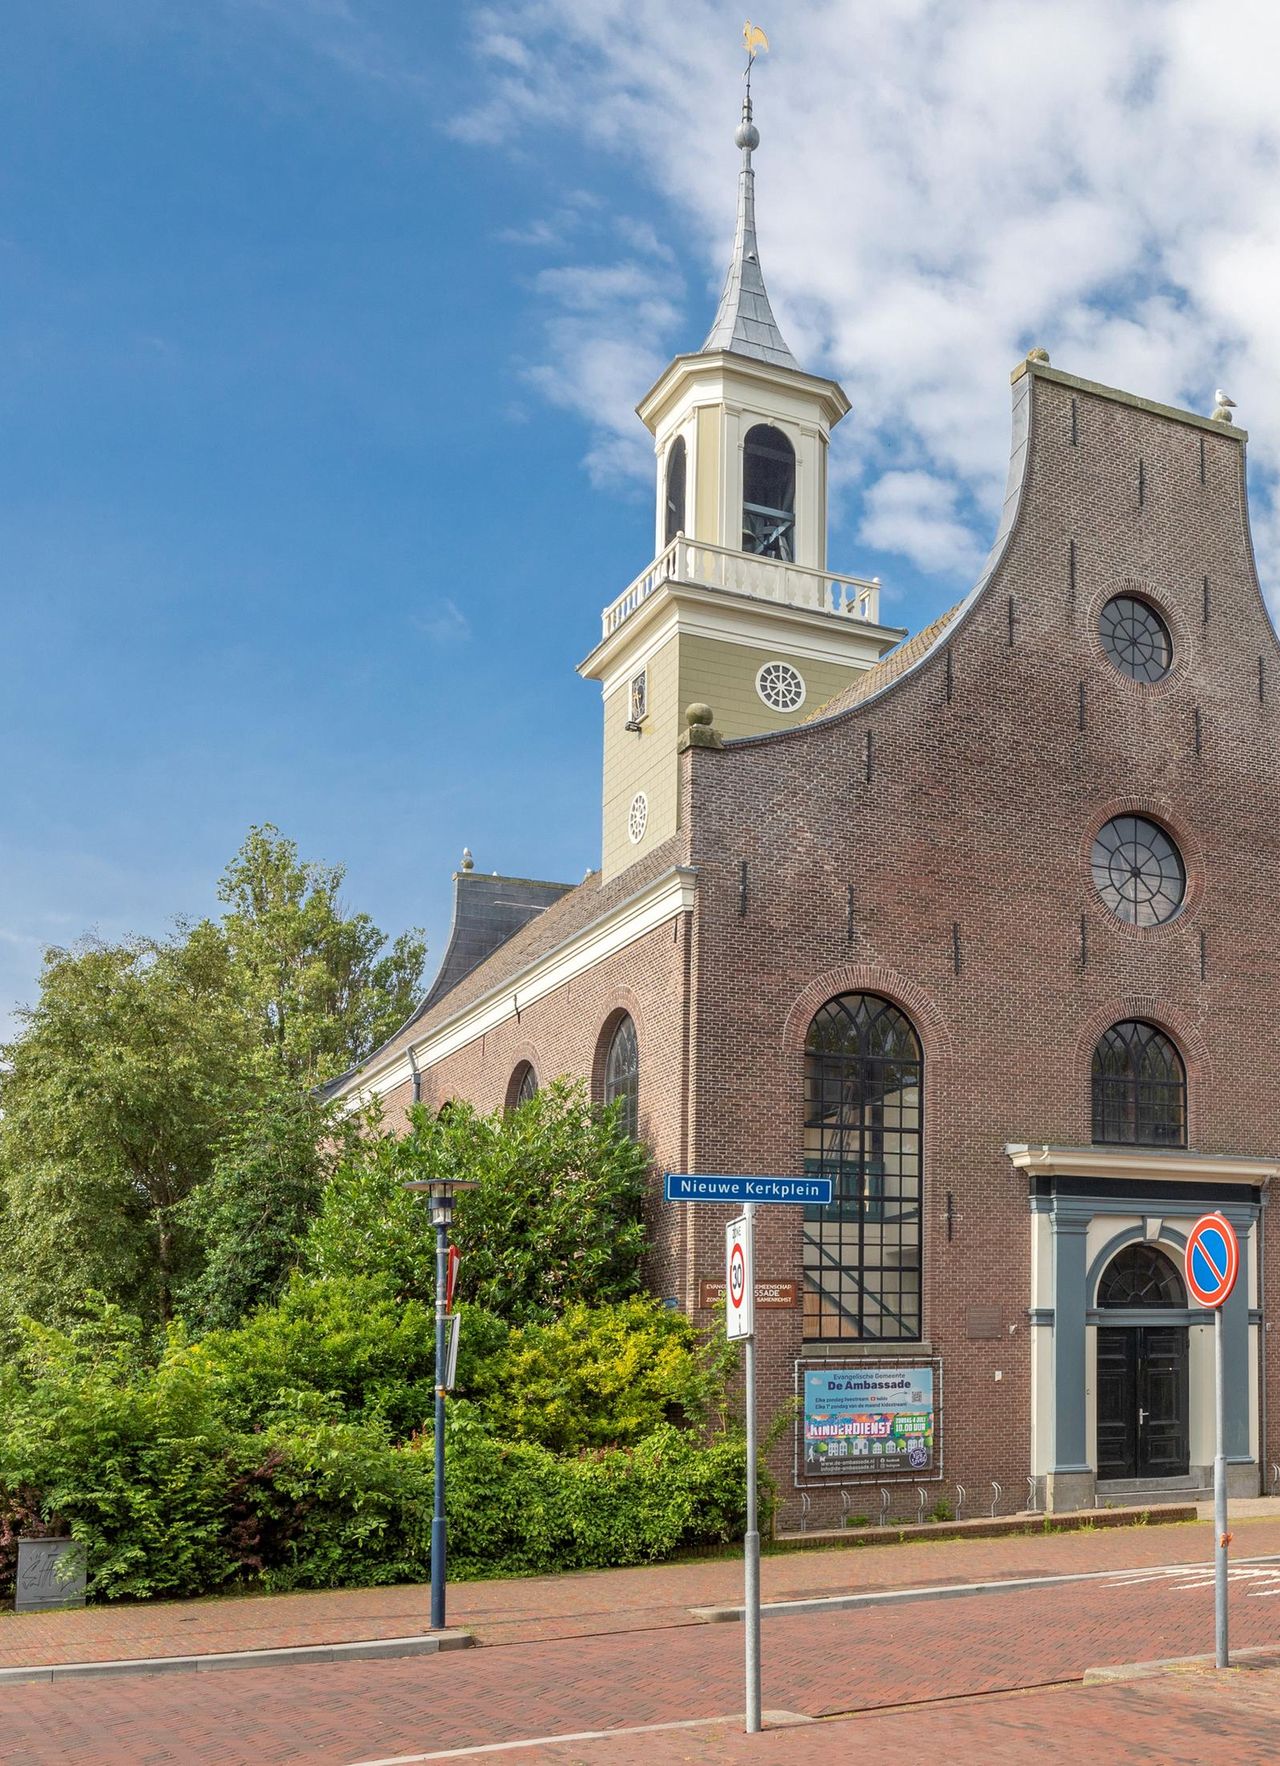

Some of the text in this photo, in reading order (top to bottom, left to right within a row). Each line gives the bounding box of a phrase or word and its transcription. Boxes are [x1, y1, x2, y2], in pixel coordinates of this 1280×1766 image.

[681, 1180, 820, 1198] Nieuwe Kerkplein
[733, 1263, 742, 1290] 30
[828, 1380, 911, 1390] De Ambassade
[810, 1422, 892, 1436] KINDERDIENST
[896, 1423, 926, 1432] 10.00 UUR
